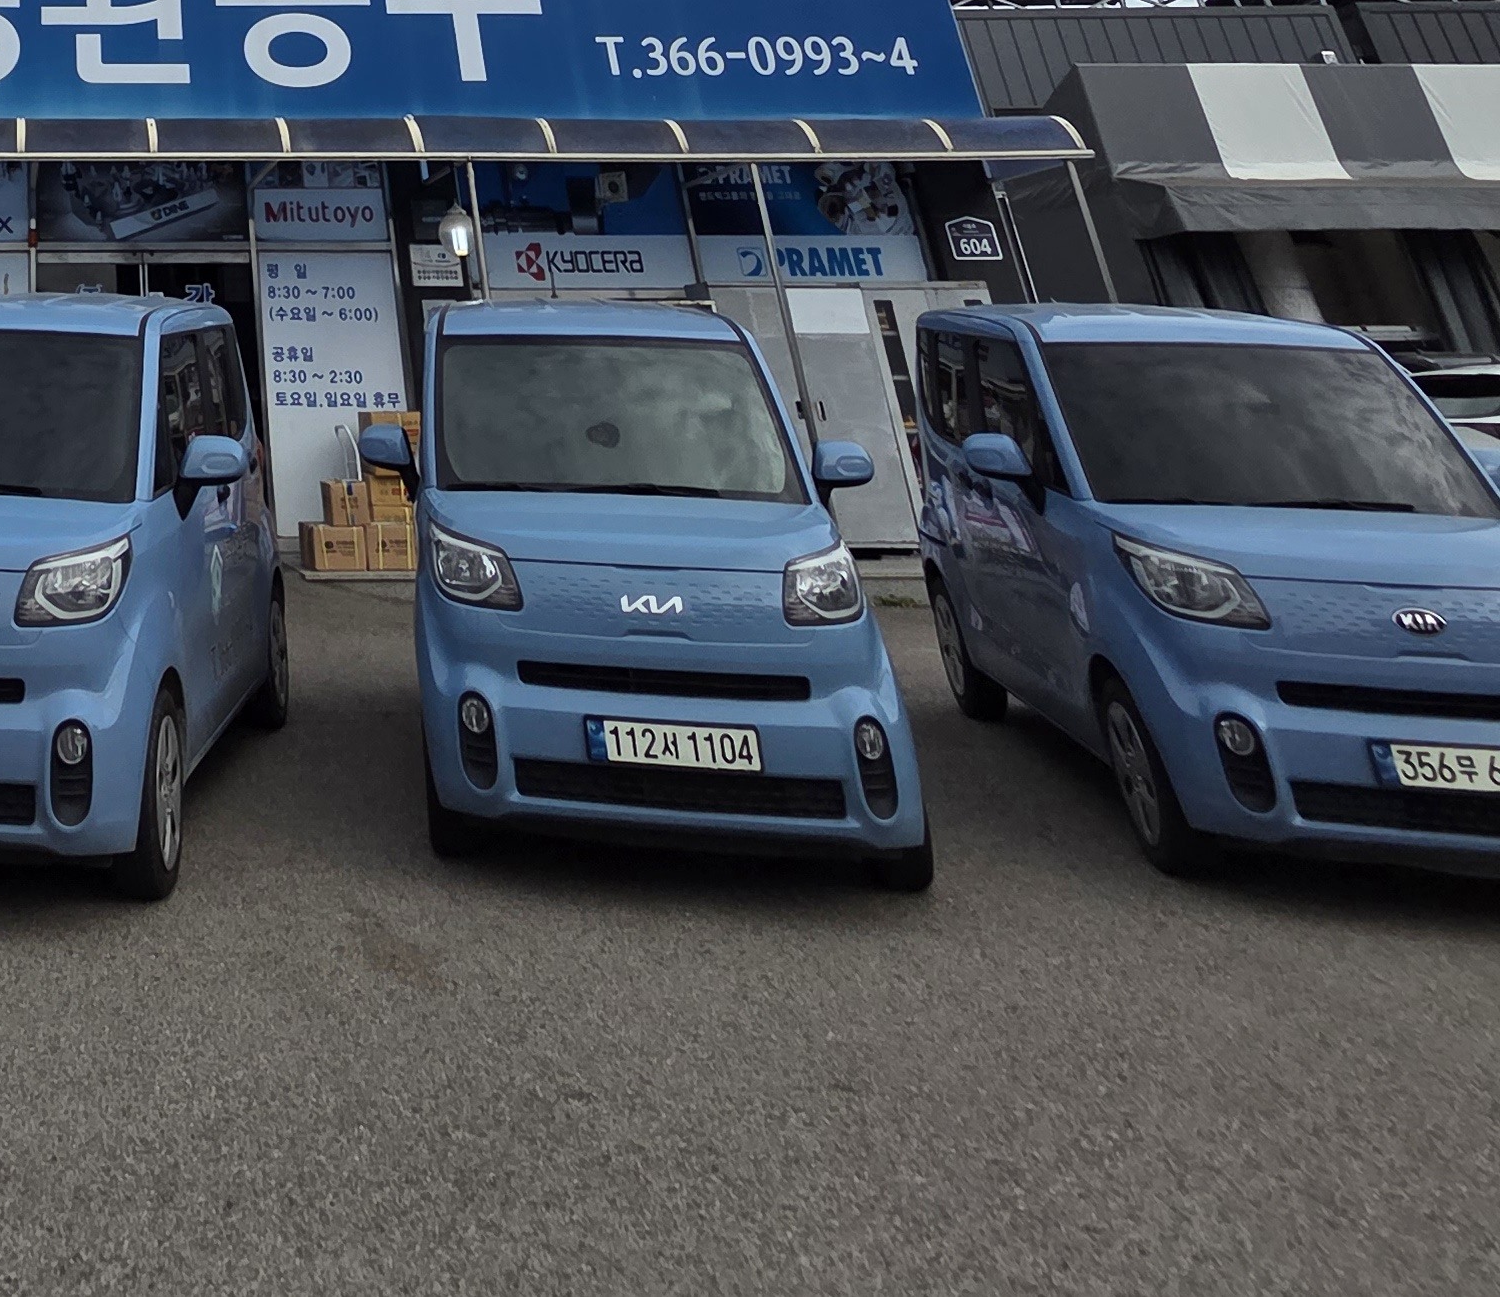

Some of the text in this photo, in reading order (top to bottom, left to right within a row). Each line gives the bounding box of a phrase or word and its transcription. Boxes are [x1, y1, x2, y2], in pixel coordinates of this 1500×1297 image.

[594, 36, 919, 79] T.366-0993~4
[263, 200, 375, 228] Mitutoyo
[960, 238, 992, 255] 604
[545, 250, 645, 273] KYOCERA
[267, 285, 301, 300] 8:30
[322, 286, 356, 300] 7:00
[271, 346, 314, 363] 공휴일
[273, 369, 307, 384] 8:30
[329, 369, 363, 384] 2:30
[372, 391, 401, 408] 휴무
[1399, 612, 1441, 632] KIA
